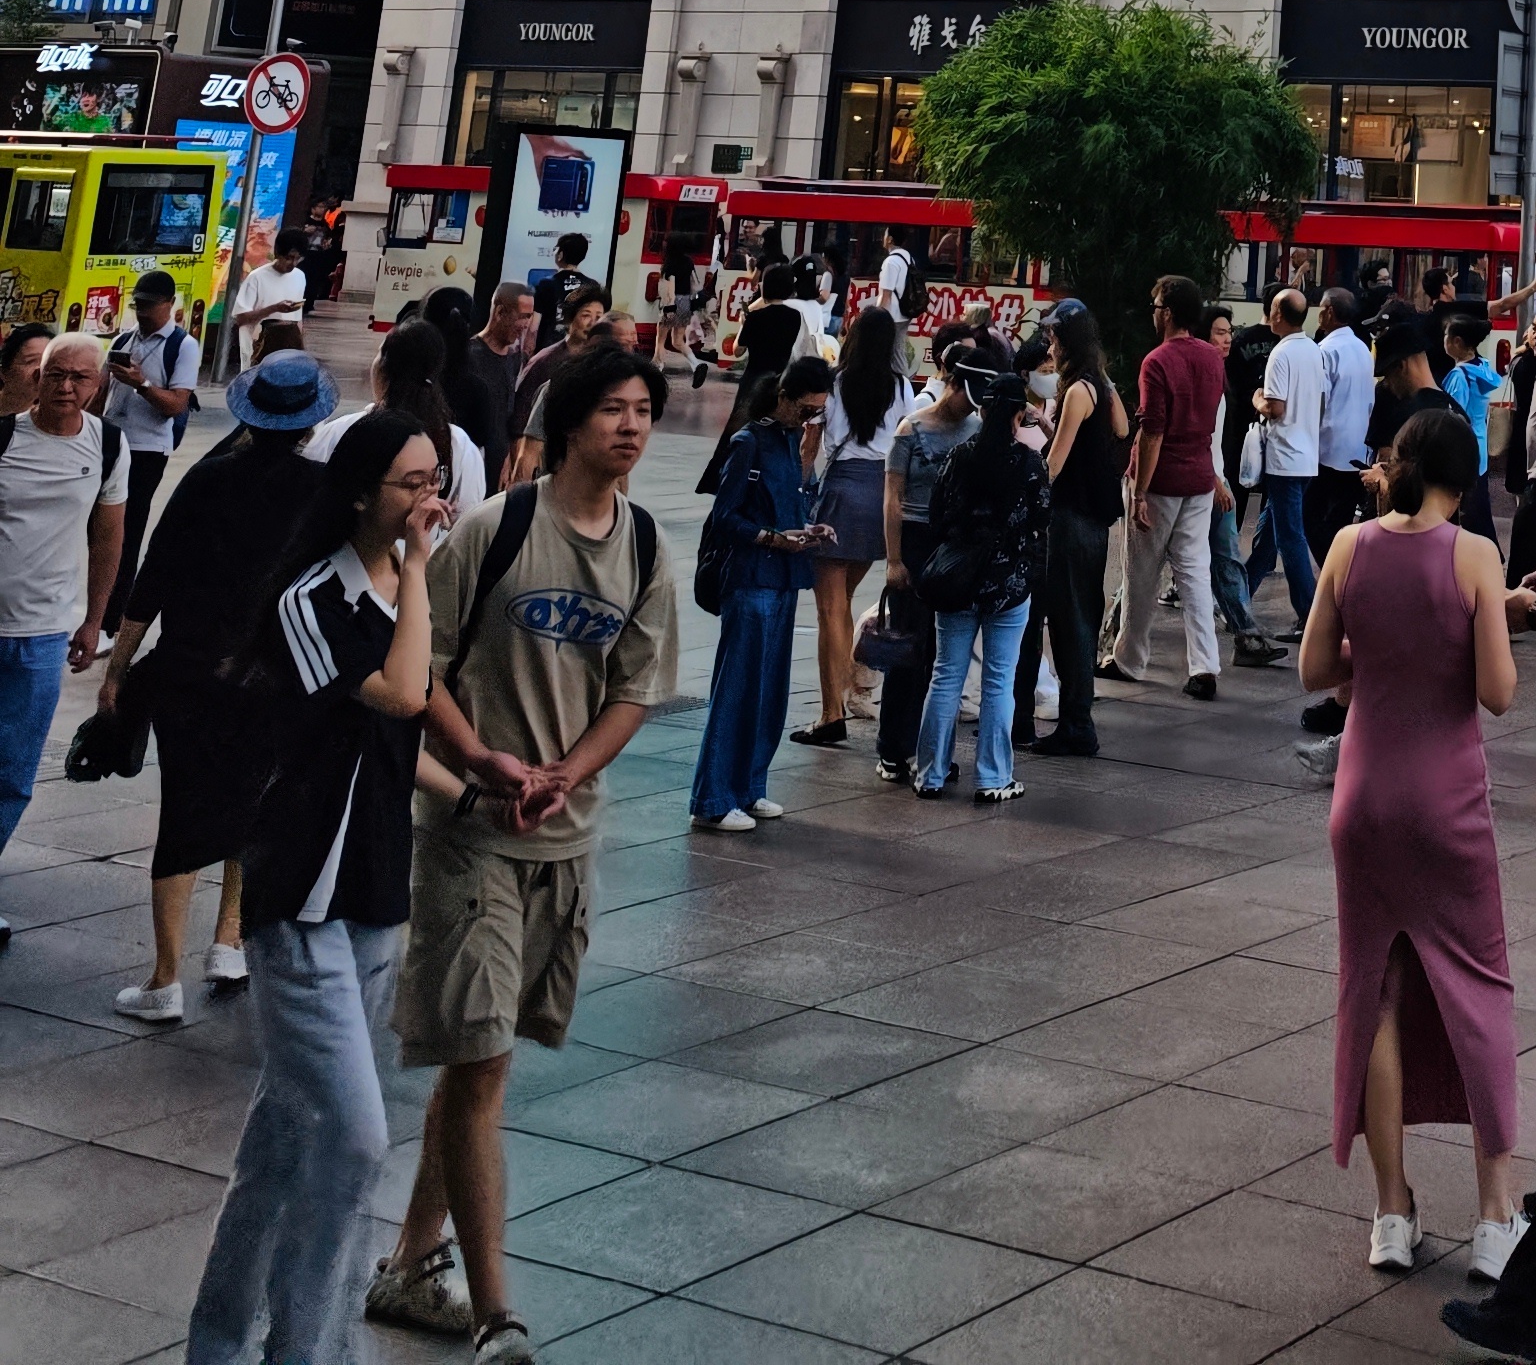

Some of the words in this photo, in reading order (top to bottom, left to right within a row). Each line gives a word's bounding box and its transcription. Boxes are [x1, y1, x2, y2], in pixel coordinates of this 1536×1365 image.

[518, 22, 596, 43] YOUNGOR
[908, 13, 988, 56] 雅戈尔
[1361, 26, 1471, 51] YOUNGOR
[36, 43, 99, 72] 可口可乐
[200, 73, 247, 108] 可口
[194, 235, 203, 251] 9
[384, 261, 423, 281] kewpie
